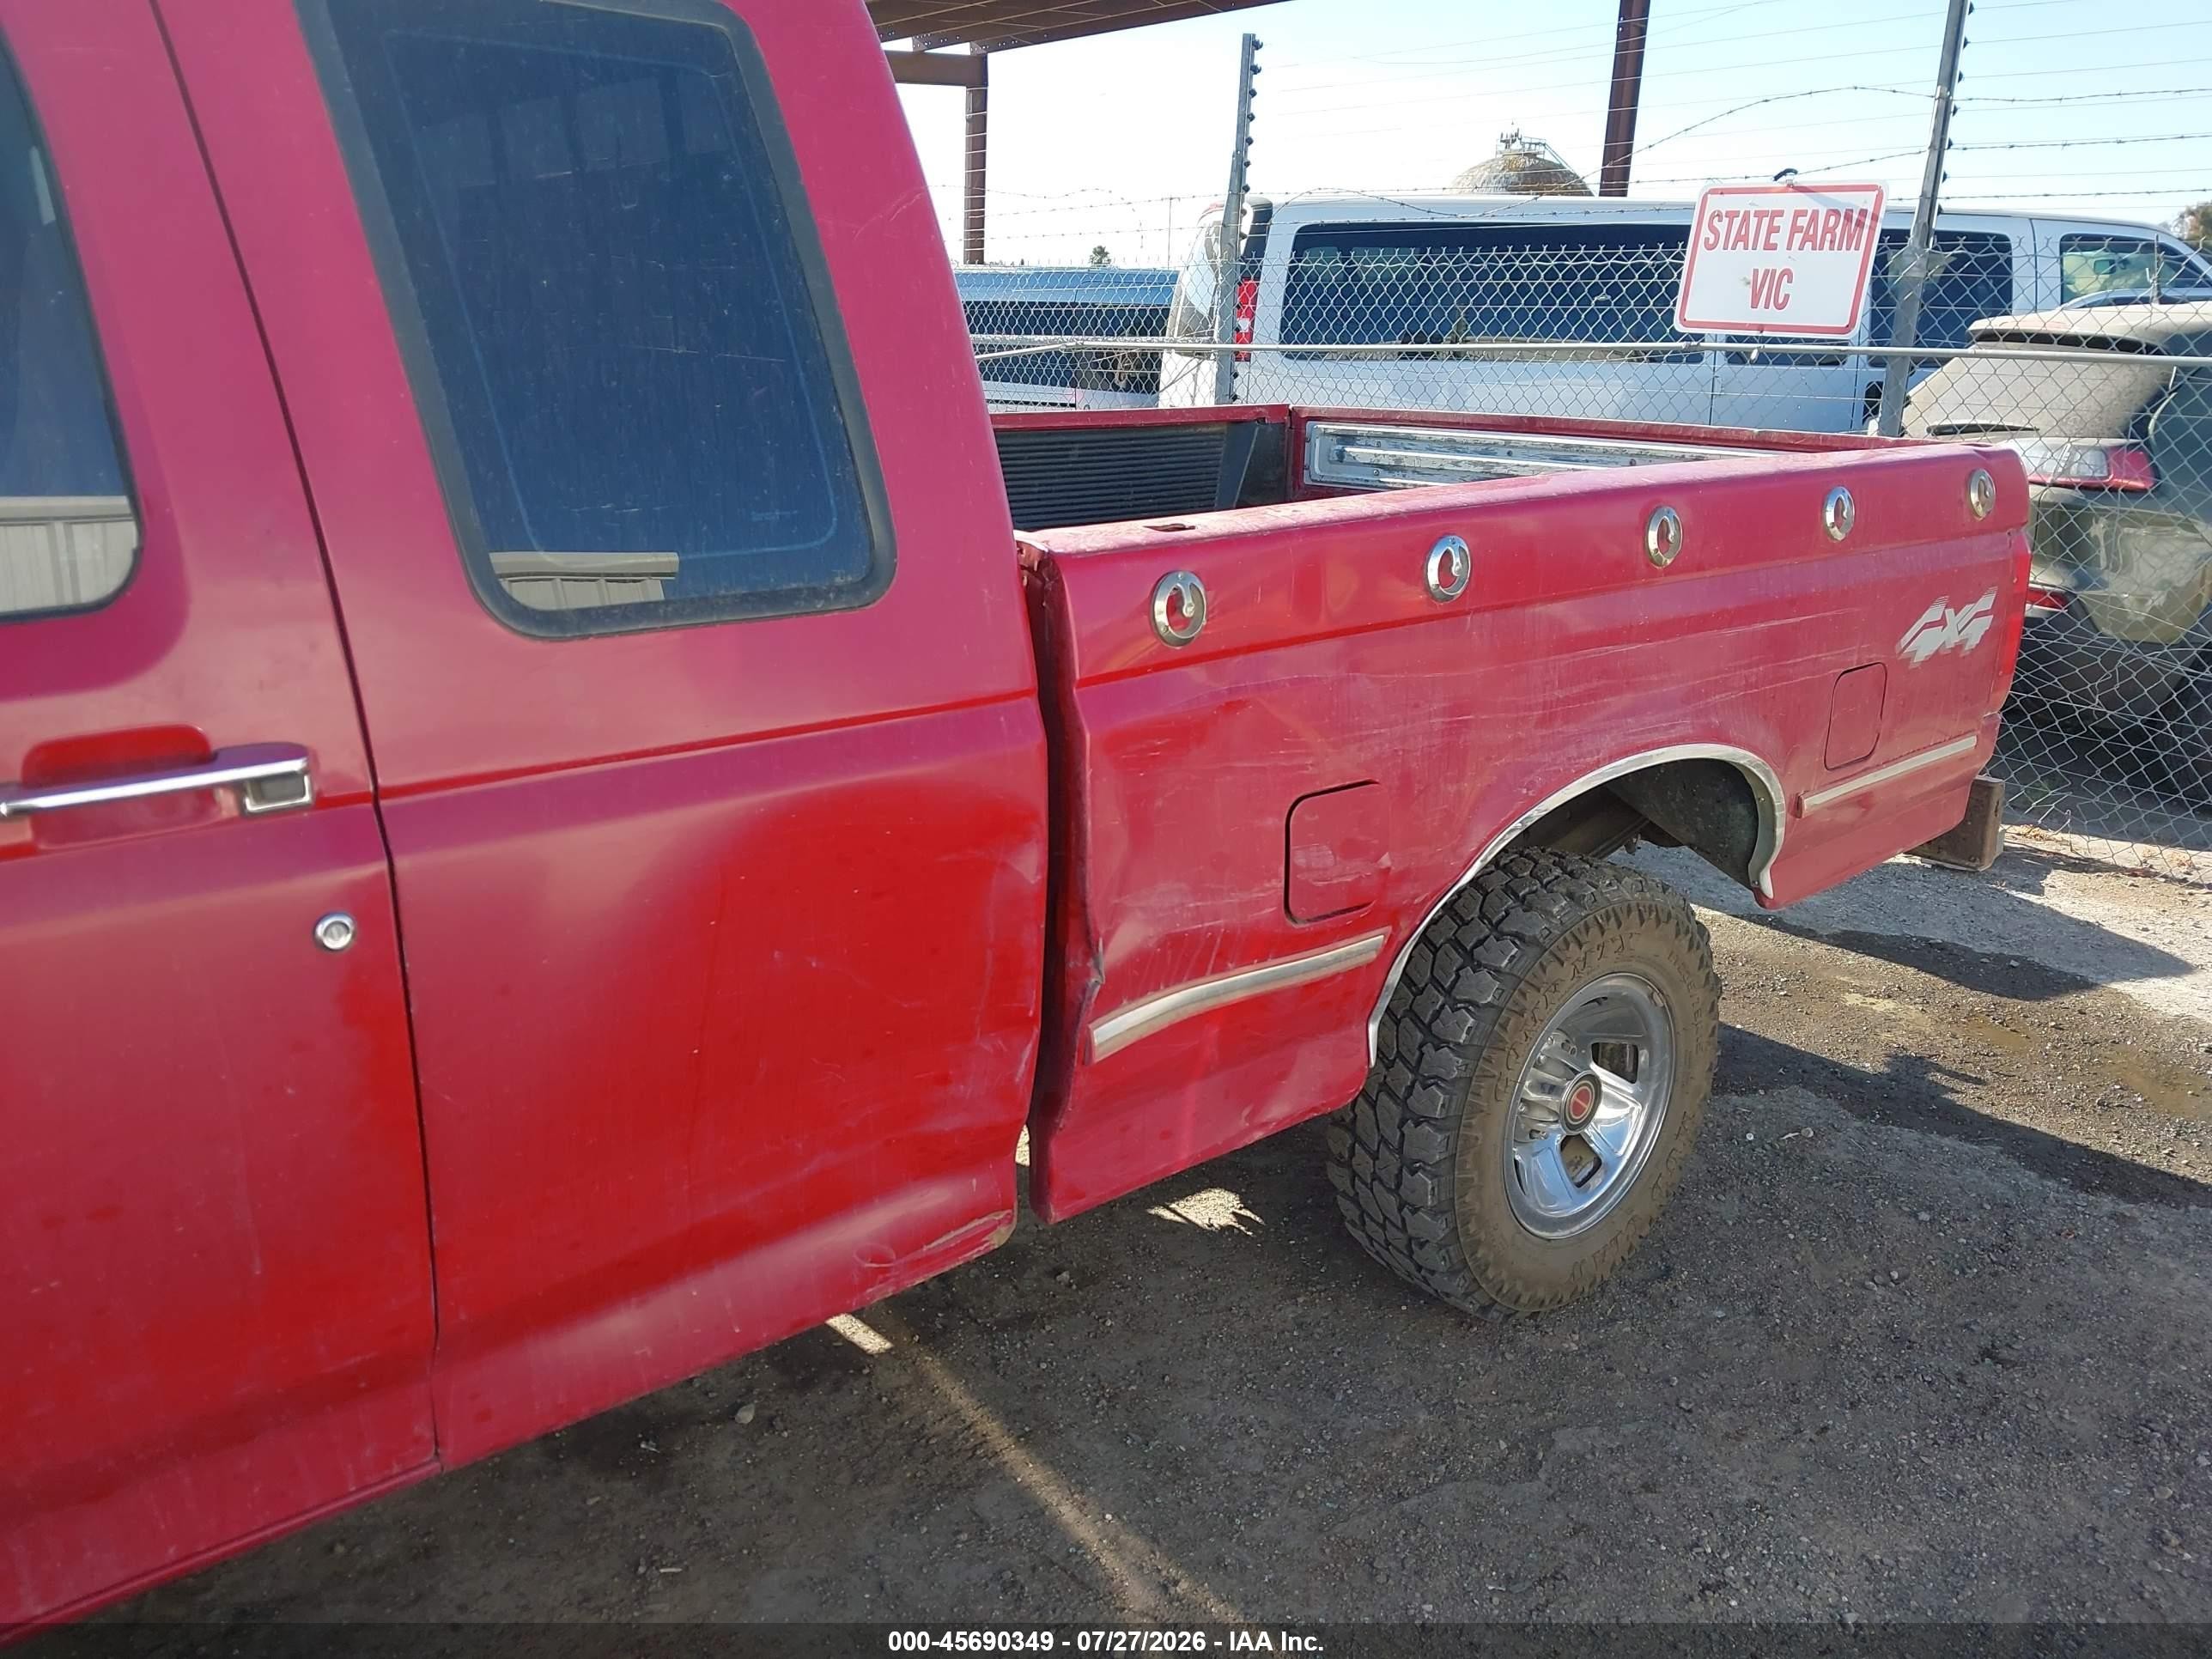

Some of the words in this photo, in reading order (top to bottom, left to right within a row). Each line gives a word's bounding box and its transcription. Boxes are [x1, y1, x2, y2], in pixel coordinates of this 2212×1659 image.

[1704, 210, 1784, 251] STATE
[1786, 208, 1868, 251] FARM
[1751, 267, 1793, 310] VIC
